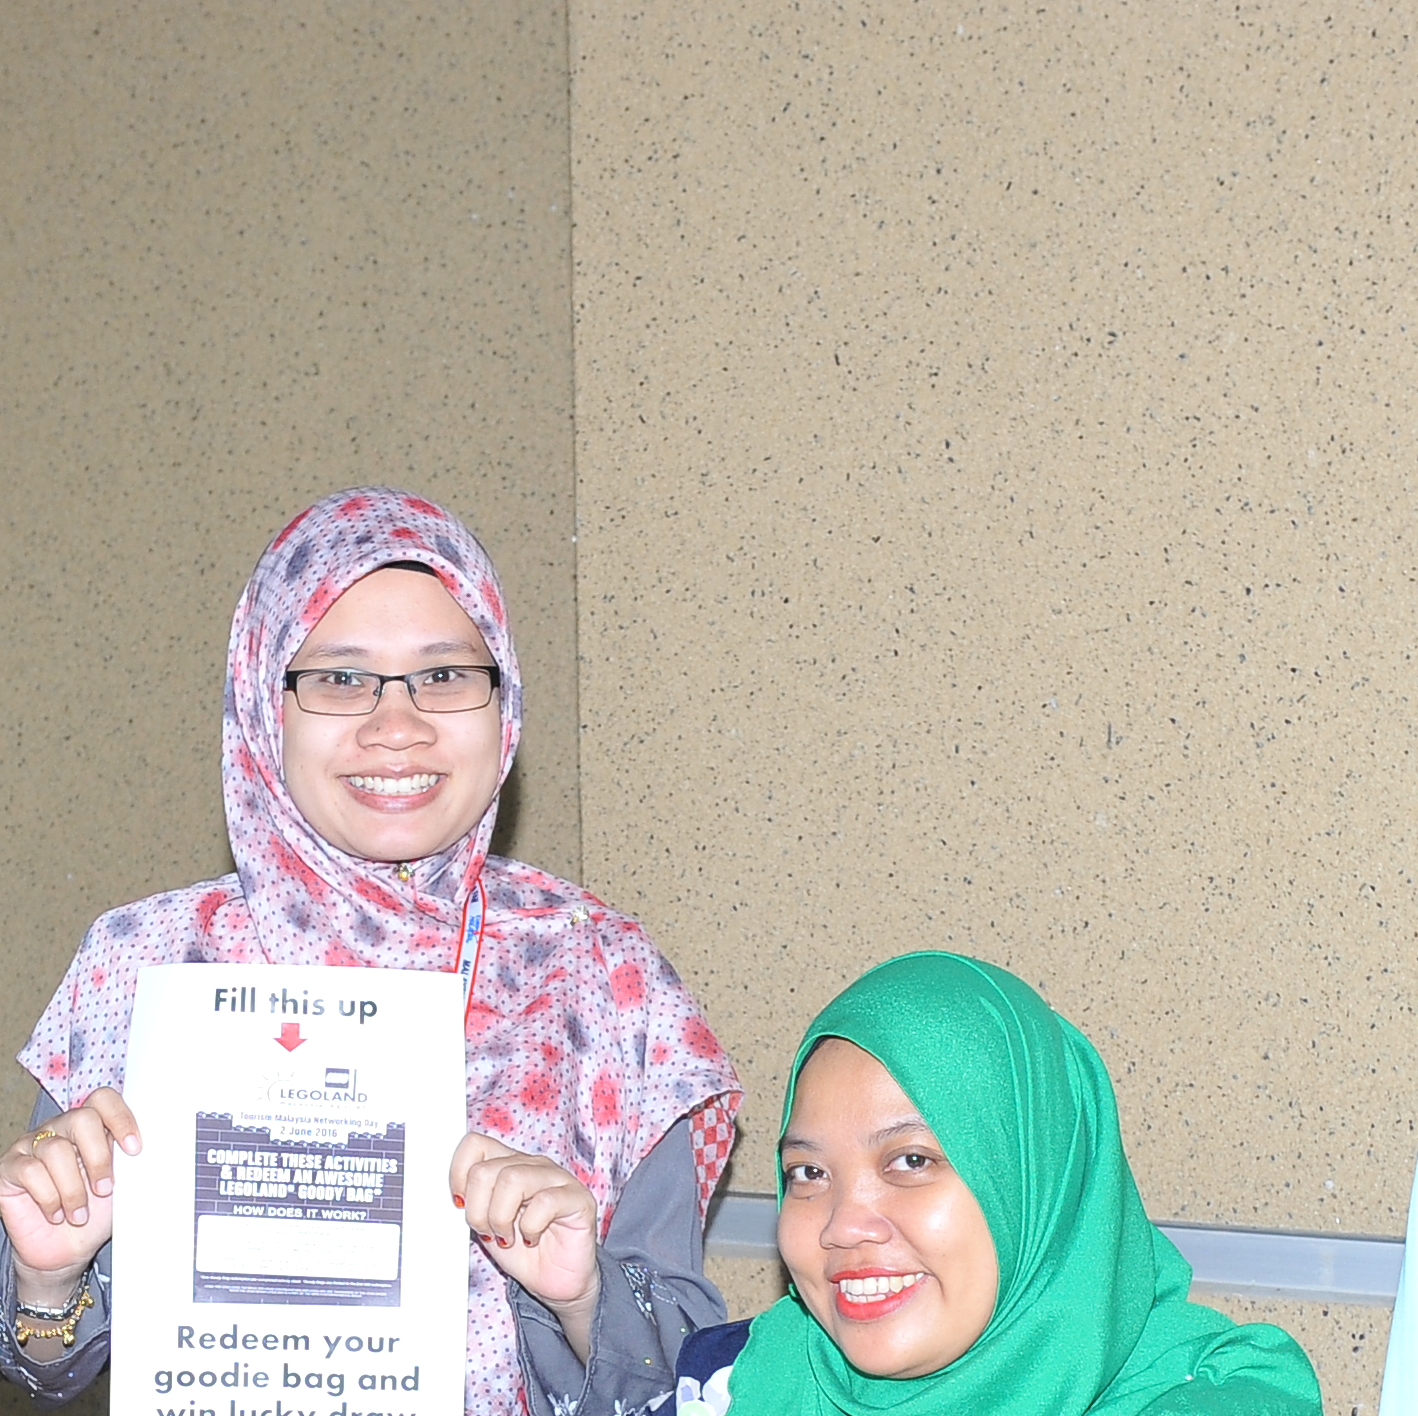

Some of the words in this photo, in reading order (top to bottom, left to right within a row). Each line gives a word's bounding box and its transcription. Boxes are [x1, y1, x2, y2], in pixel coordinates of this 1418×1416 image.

[214, 987, 256, 1013] Fill
[268, 988, 325, 1016] this
[338, 996, 378, 1024] up
[280, 1086, 368, 1103] LEGOLAND
[275, 1114, 311, 1125] Malaysia
[313, 1116, 362, 1127] Networking
[364, 1119, 379, 1129] Day
[280, 1126, 286, 1135] 2
[288, 1127, 312, 1137] June
[315, 1128, 338, 1138] 2016
[207, 1149, 278, 1167] COMPLETE
[280, 1153, 323, 1169] THESE
[324, 1156, 398, 1174] ACTIVITIES
[220, 1165, 233, 1180] &
[237, 1166, 291, 1183] REDEEM
[293, 1169, 313, 1185] AN
[315, 1170, 384, 1188] AWESOME
[297, 1185, 344, 1202] GOODY
[233, 1205, 264, 1216] HOW
[267, 1206, 303, 1218] DOES
[306, 1208, 319, 1219] IT
[321, 1209, 367, 1221] WORK?
[177, 1325, 311, 1352] Redeem
[324, 1334, 401, 1359] your
[154, 1363, 270, 1394] goodie
[282, 1364, 346, 1397] bag
[357, 1366, 420, 1392] and
